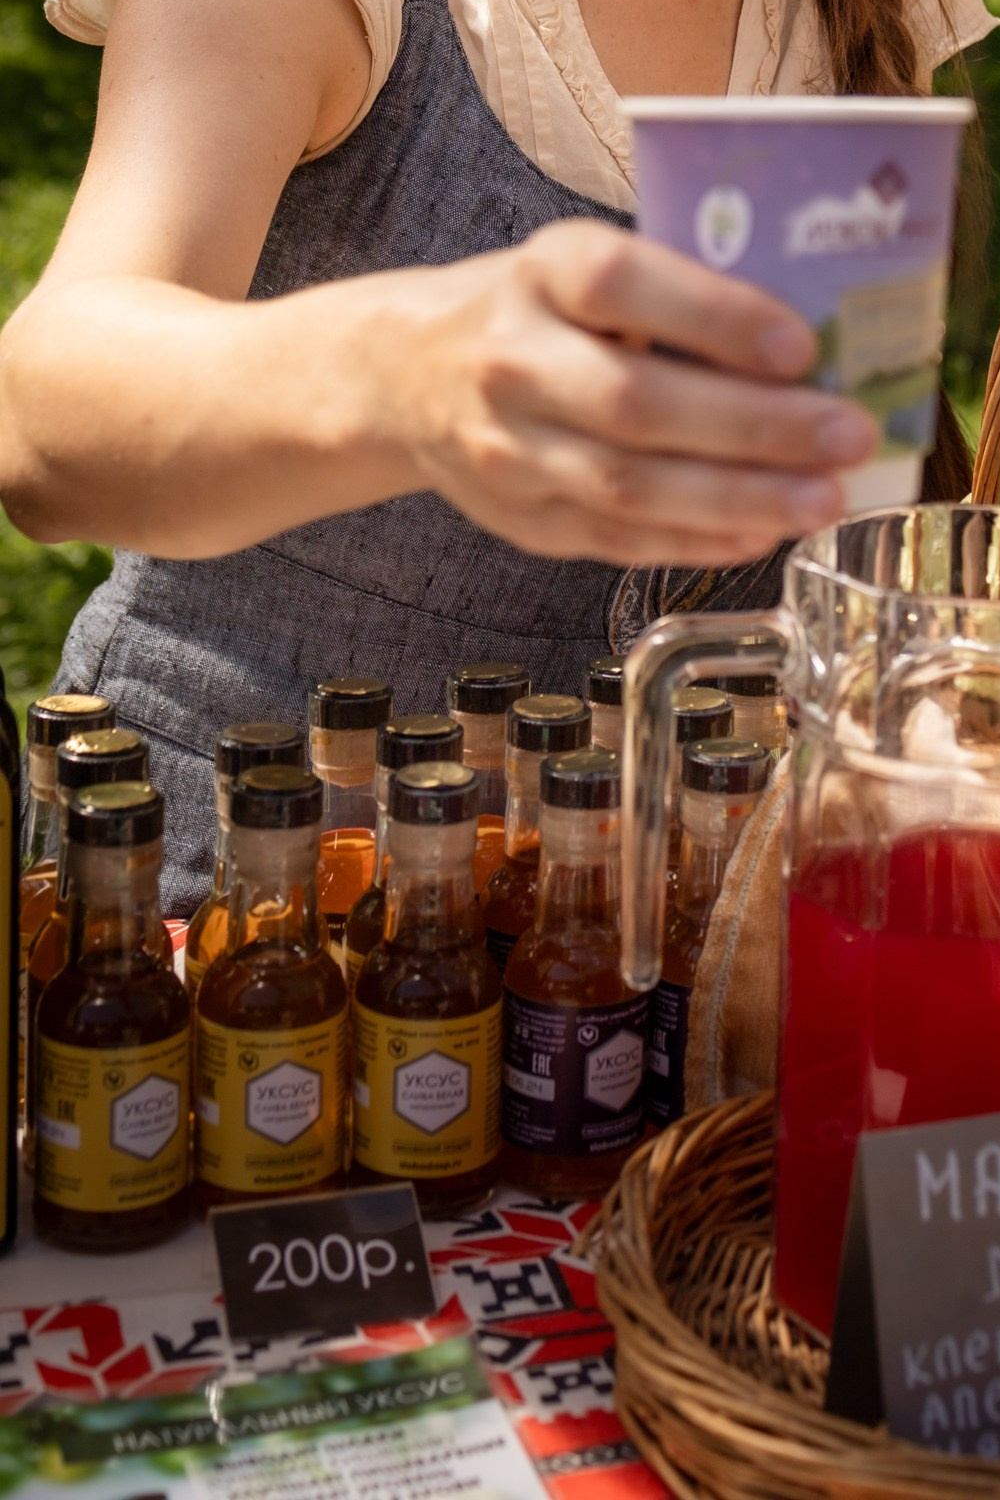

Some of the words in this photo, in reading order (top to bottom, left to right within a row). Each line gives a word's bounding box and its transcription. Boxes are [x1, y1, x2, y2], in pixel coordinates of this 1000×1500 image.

[595, 1045, 640, 1072] УКСУС
[256, 1081, 314, 1101] УКСУС
[404, 1070, 462, 1089] УКСУС
[122, 1091, 174, 1119] УКСУС
[247, 1232, 416, 1293] 200р.
[350, 1371, 467, 1413] УКСУС
